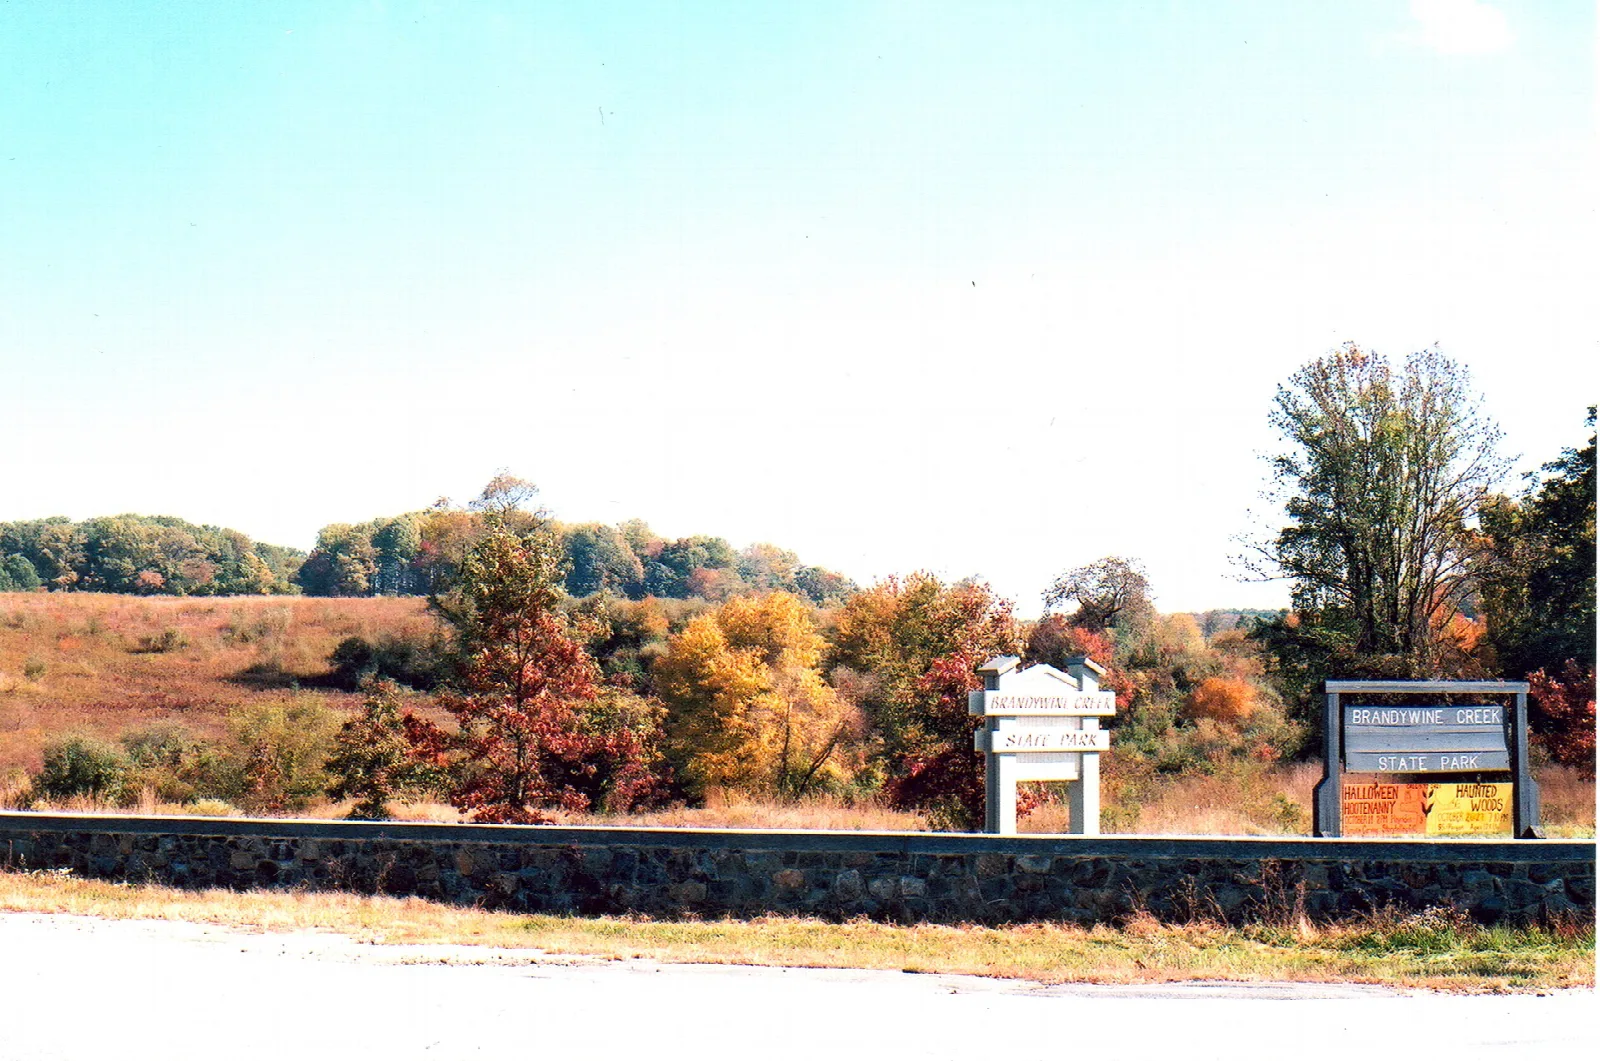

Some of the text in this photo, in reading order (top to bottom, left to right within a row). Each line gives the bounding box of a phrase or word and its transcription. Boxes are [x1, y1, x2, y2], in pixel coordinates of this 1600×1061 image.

[990, 696, 1112, 709] BRANDYWINE CREEK
[1352, 709, 1500, 724] BRANDYWINE CREEK
[1060, 733, 1097, 746] PARK
[1378, 756, 1479, 771] STATE PARK
[1344, 785, 1399, 800] HALLOWEEN
[1456, 784, 1498, 798] HAUNTED
[1344, 801, 1397, 815] HOOTENANNY
[1471, 799, 1503, 812] WOODS
